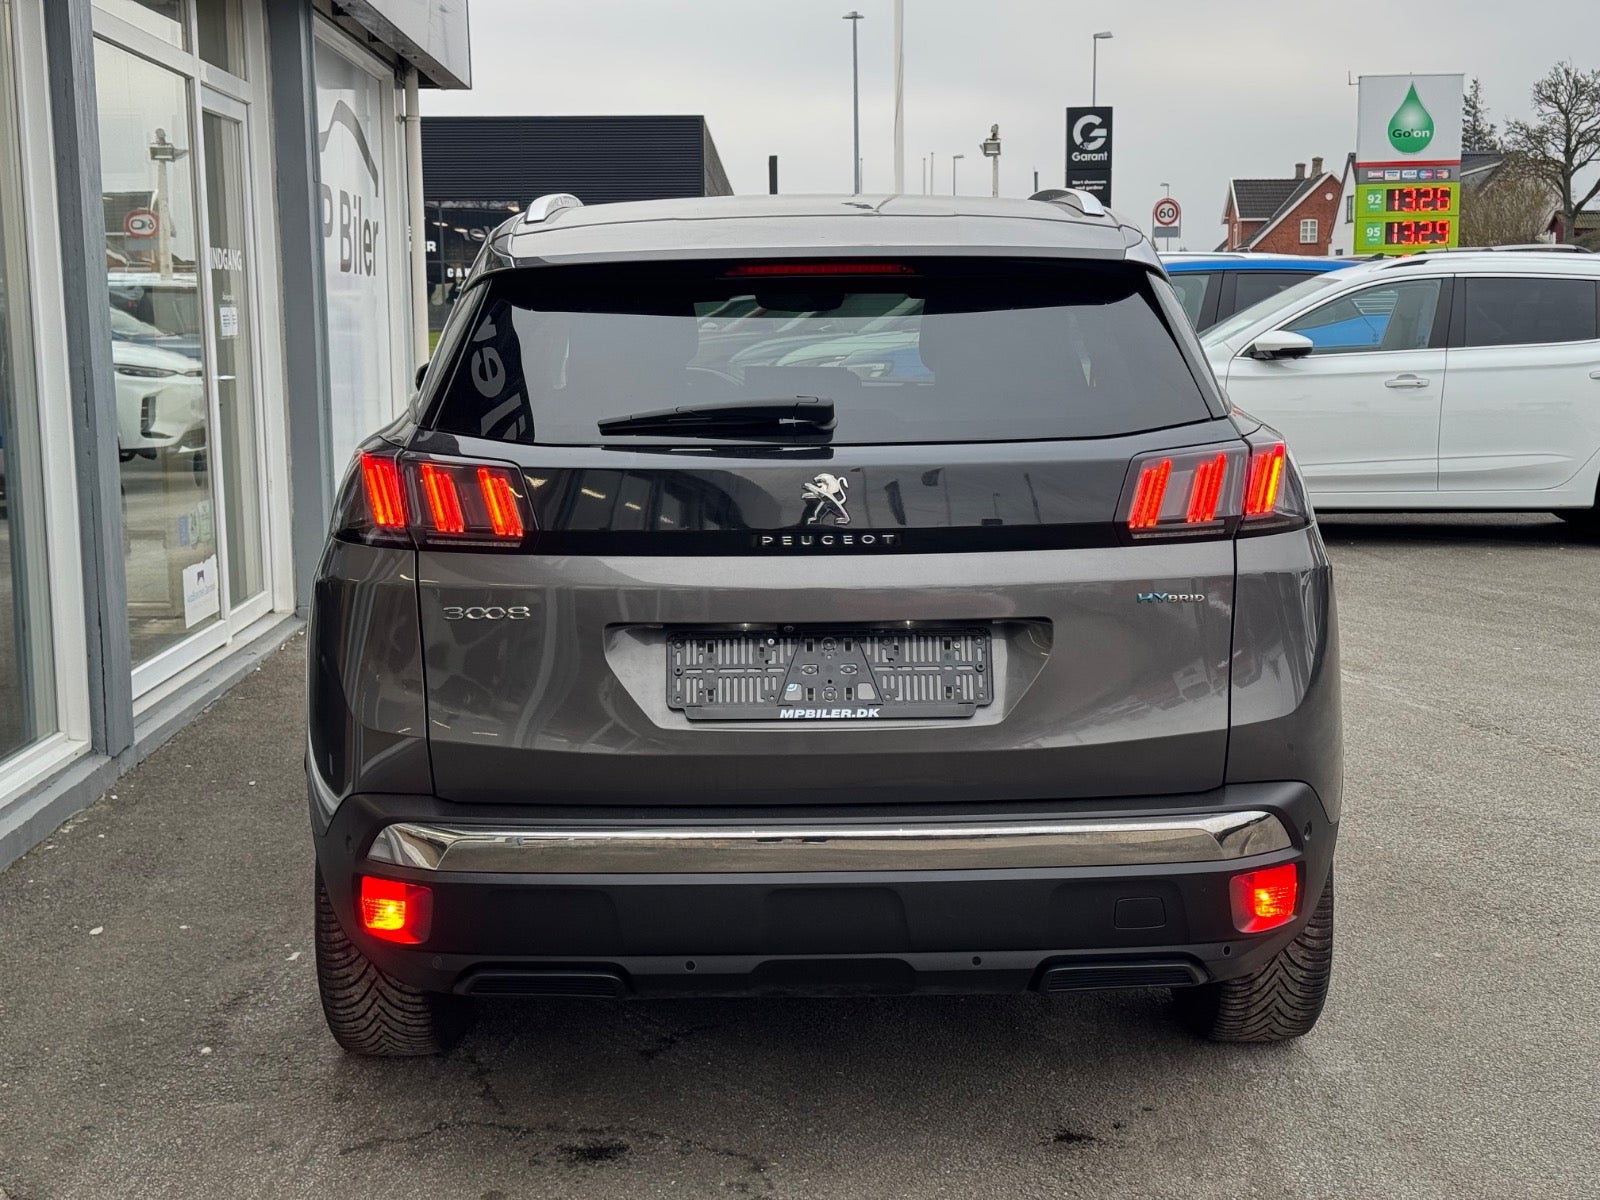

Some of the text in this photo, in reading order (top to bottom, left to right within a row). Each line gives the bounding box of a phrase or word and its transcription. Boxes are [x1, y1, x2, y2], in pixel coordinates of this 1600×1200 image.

[1072, 151, 1108, 161] Garant
[1367, 187, 1451, 212] 92 13.26
[1159, 208, 1175, 219] 60
[340, 190, 379, 277] Biler
[1366, 219, 1449, 245] 95 13.29
[761, 535, 895, 546] PEUGEOT
[443, 606, 531, 620] 3008
[780, 708, 880, 719] MPBILER.DK
